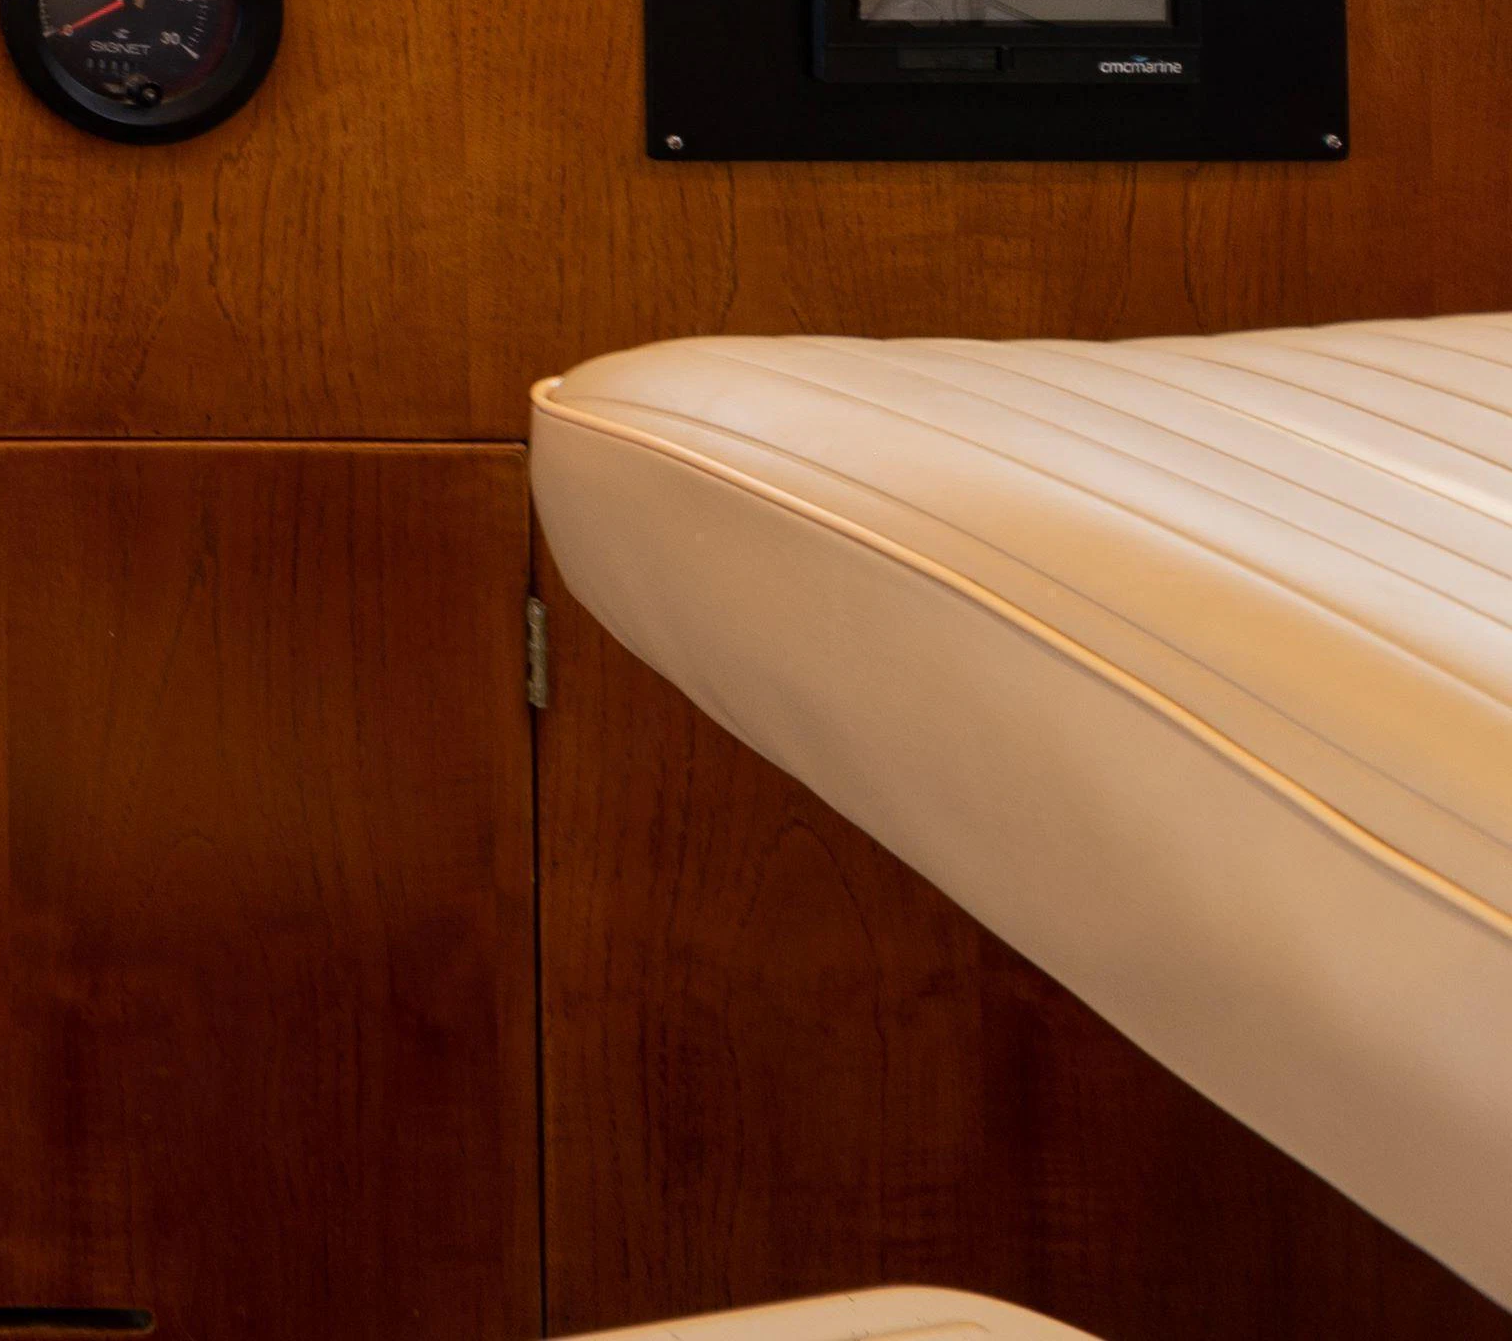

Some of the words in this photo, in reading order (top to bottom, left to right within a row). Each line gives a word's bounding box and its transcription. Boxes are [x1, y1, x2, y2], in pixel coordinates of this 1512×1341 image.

[159, 30, 181, 45] 30
[89, 40, 152, 56] SIGNET
[1098, 59, 1183, 74] cmcmarine
